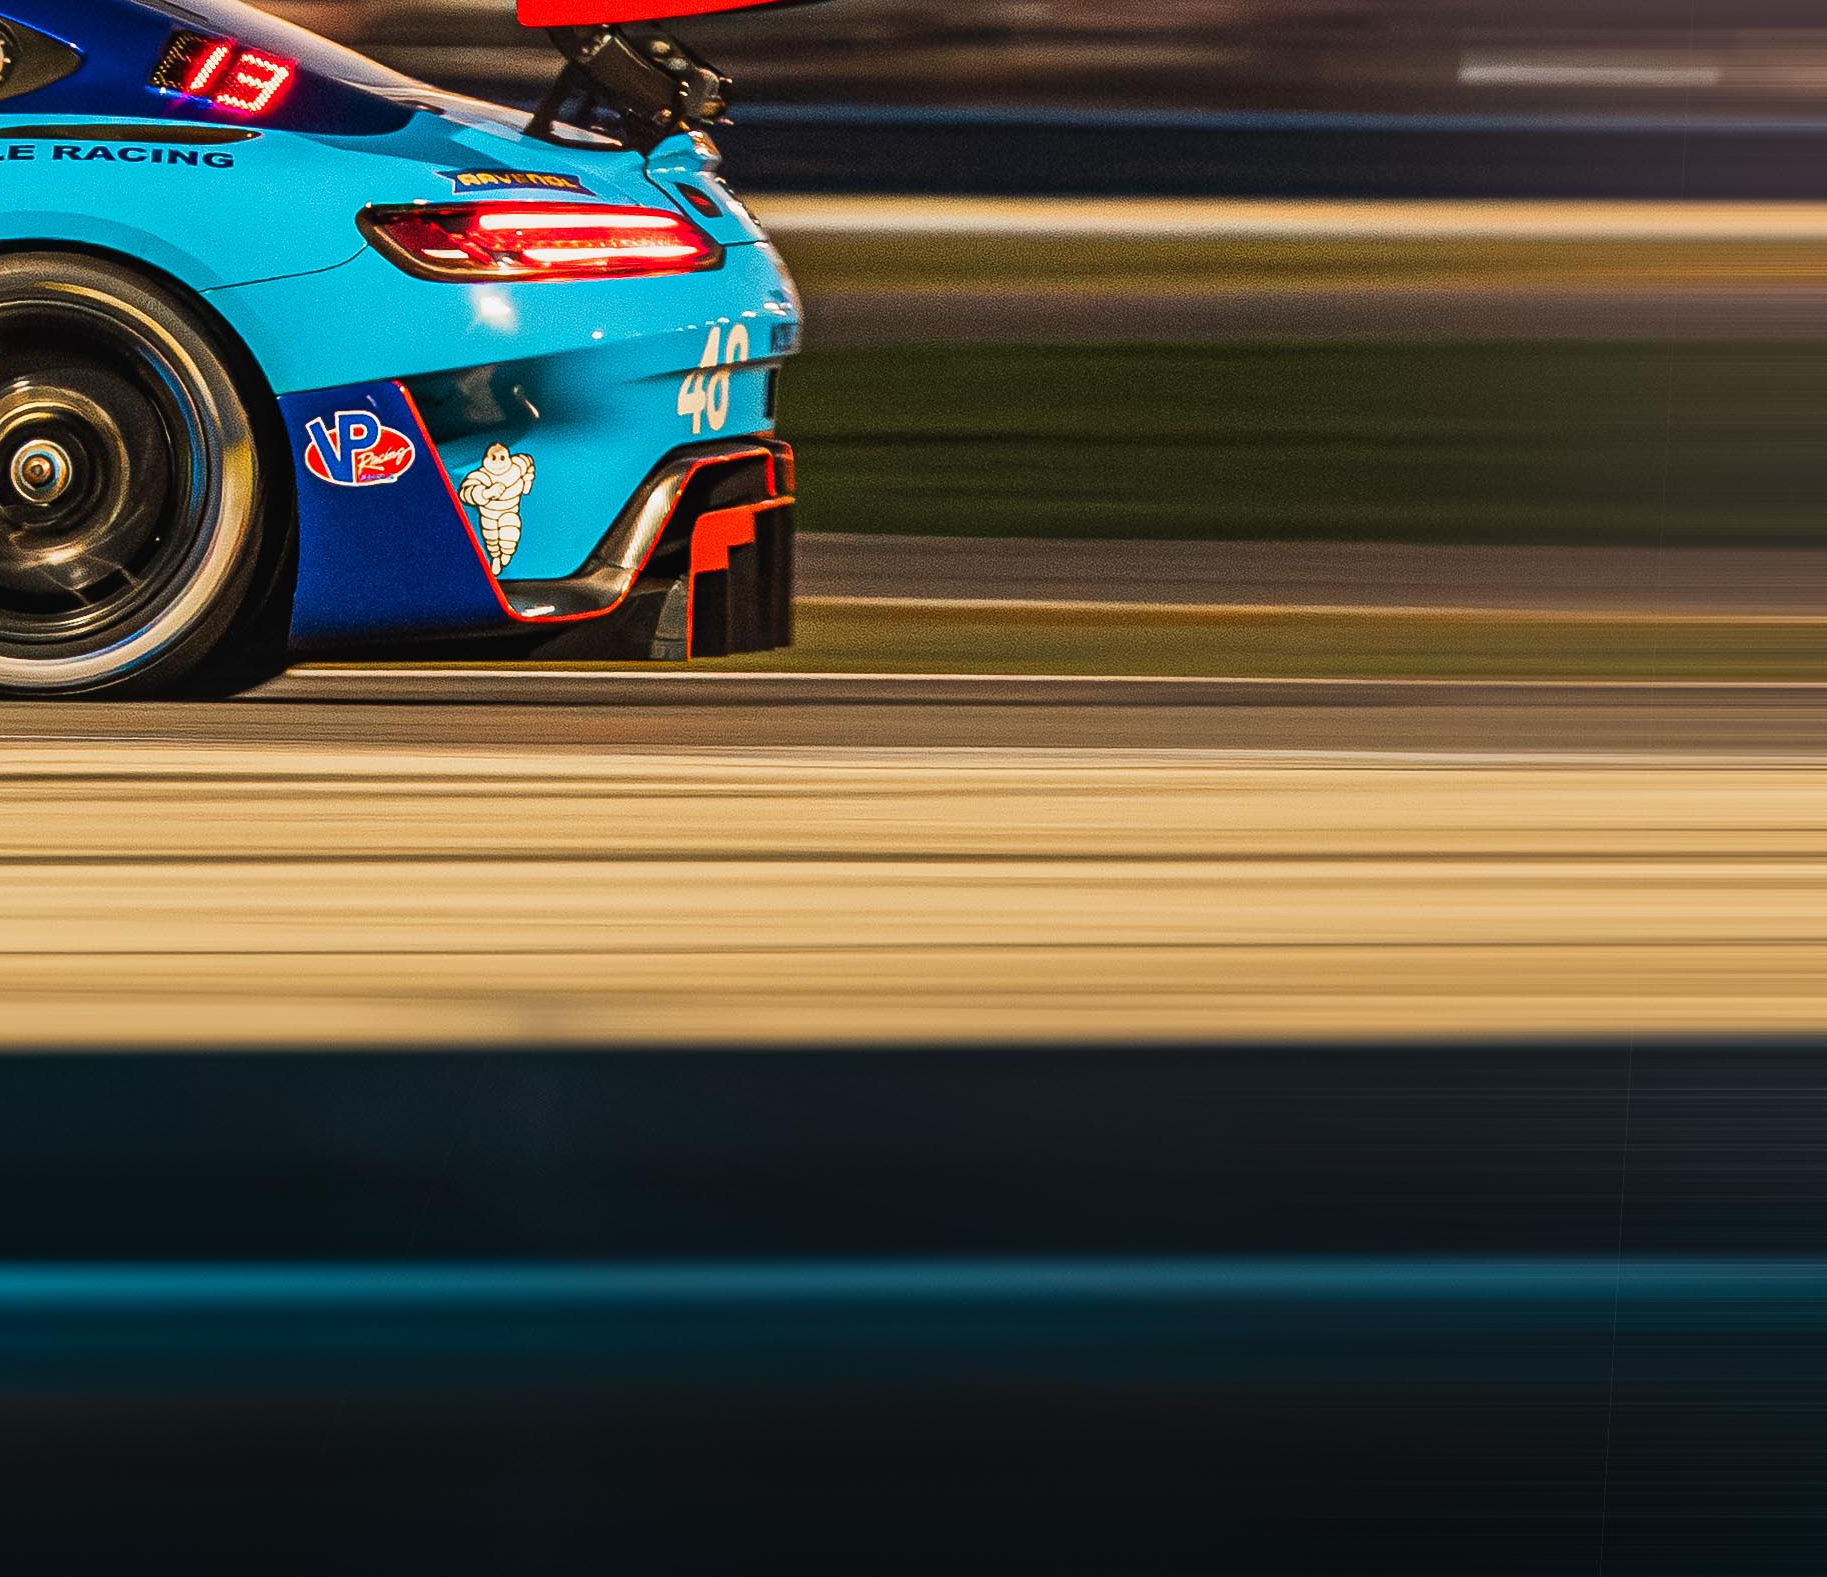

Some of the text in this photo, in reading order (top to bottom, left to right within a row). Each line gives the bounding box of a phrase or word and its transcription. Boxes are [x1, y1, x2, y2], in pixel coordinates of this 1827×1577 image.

[187, 43, 291, 113] 13
[51, 146, 235, 169] RACING
[305, 410, 382, 485] VP
[357, 446, 413, 477] Racing
